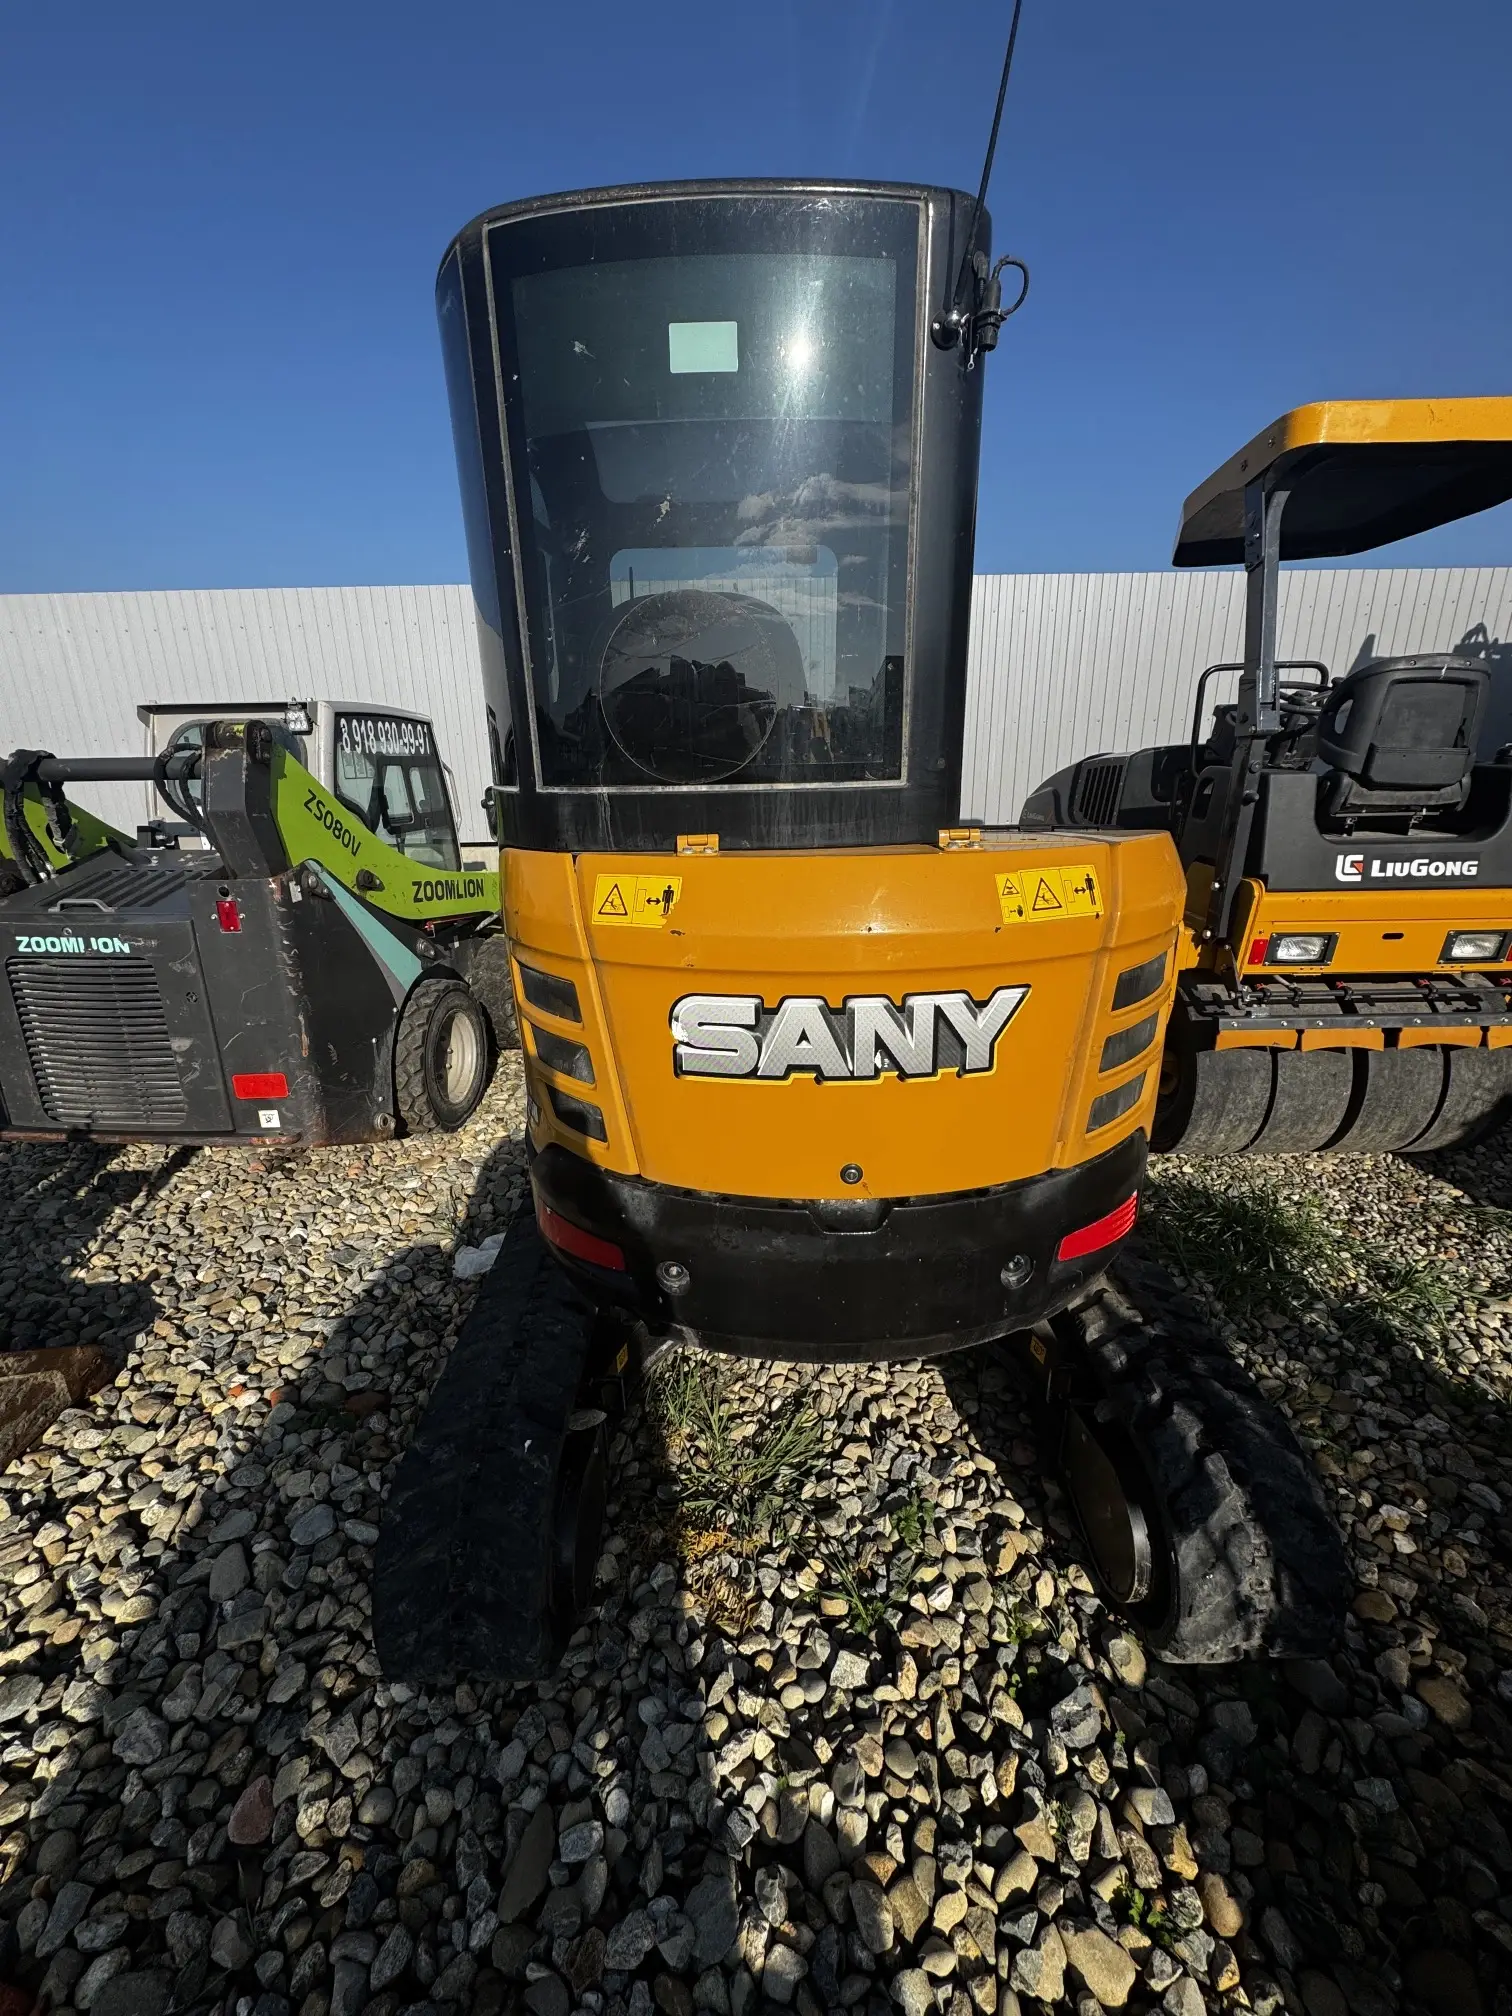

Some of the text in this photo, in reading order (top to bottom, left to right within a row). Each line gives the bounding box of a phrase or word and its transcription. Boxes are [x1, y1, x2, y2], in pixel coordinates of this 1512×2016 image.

[340, 718, 430, 755] 8 918 930-99-91
[303, 788, 362, 857] ZS080V
[412, 878, 485, 903] ZOOMLION
[670, 984, 1031, 1081] SANY
